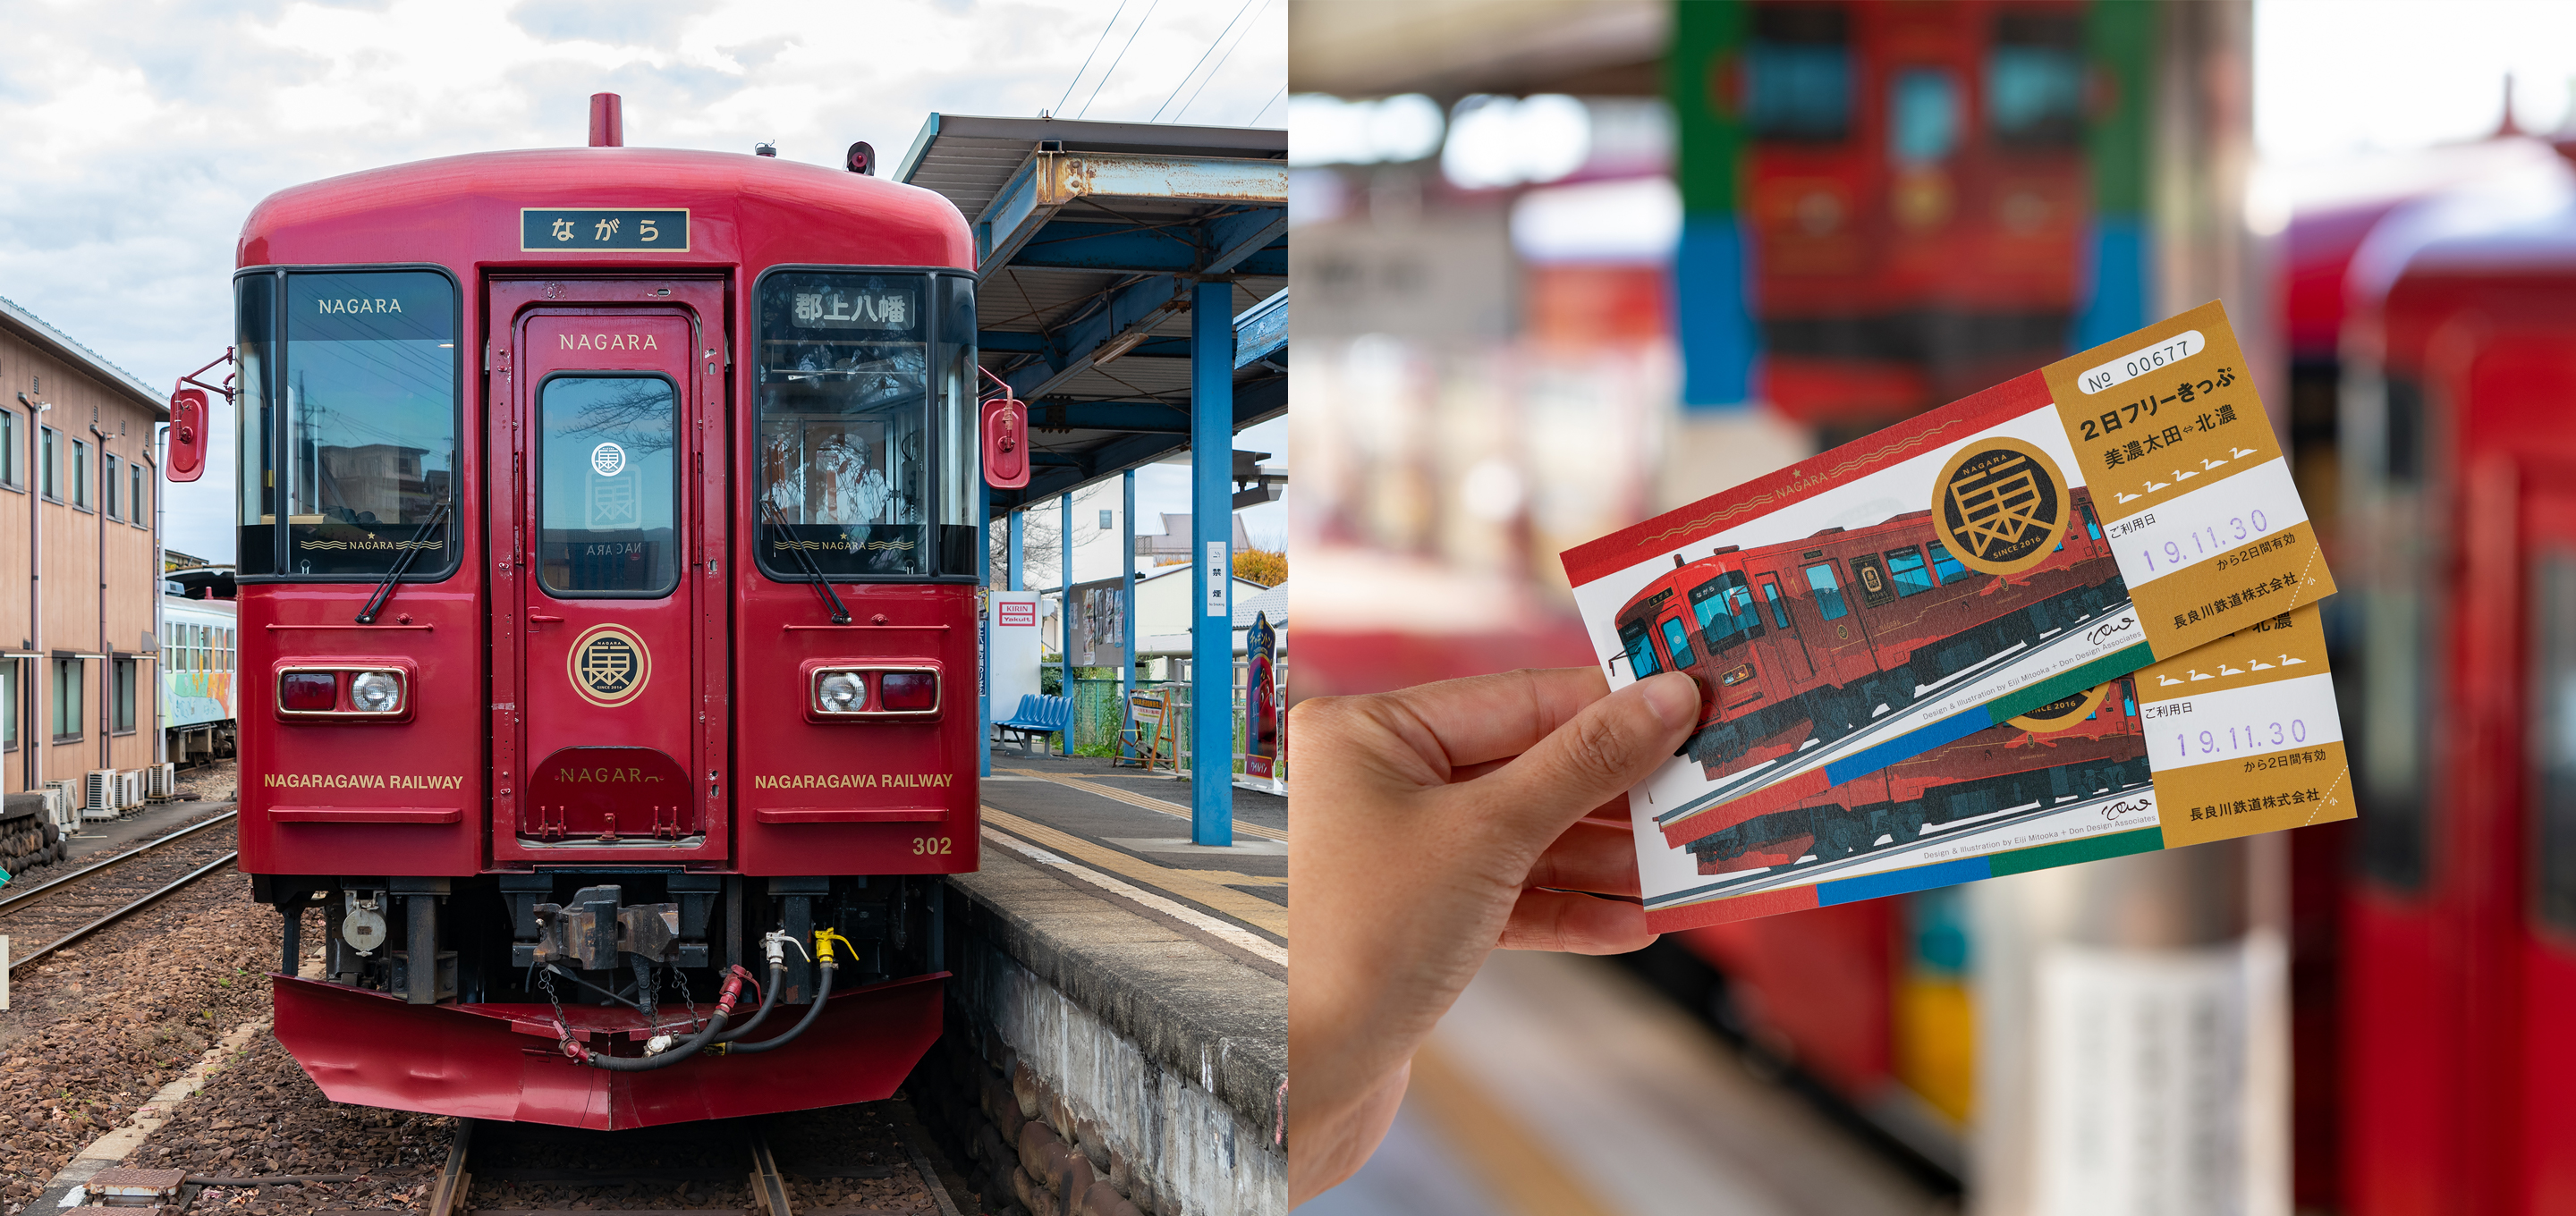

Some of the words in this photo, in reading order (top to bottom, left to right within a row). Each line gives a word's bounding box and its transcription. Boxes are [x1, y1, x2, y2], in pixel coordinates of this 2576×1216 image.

[552, 217, 659, 241] ながら
[318, 299, 402, 315] NAGARA
[794, 292, 905, 323] 郡上八幡
[559, 334, 657, 350] NAGARA
[2126, 341, 2190, 376] 00677
[2080, 367, 2237, 442] 2日フリーきっぷ
[1962, 454, 2007, 475] NAGARA
[1775, 472, 1828, 499] NAGARA
[2109, 513, 2157, 540] ご利用日
[349, 541, 394, 551] NAGARA
[822, 541, 866, 550] NAGARA
[1993, 544, 2018, 559] SINCE
[2021, 536, 2041, 549] 2016
[2216, 533, 2296, 571] から2日間有効
[1212, 568, 1221, 597] 禁煙
[1696, 586, 1715, 598] ながら
[2306, 576, 2317, 587] 小
[2174, 571, 2299, 629] 長良川鉄道株式会社
[1923, 705, 1948, 721] Design
[1949, 702, 1956, 710] &
[1956, 687, 1996, 708] Illustration
[1997, 682, 2007, 692] by
[2008, 676, 2020, 689] Eiji
[2021, 666, 2050, 684] Mitooka
[2059, 657, 2074, 668] Don
[2075, 646, 2101, 662] Design
[2102, 630, 2142, 650] Associates
[2055, 700, 2076, 710] 2016
[2145, 702, 2193, 720] ご利用日
[2177, 719, 2306, 756] 19.11.30
[2243, 748, 2326, 773] から2日間有効
[264, 773, 385, 789] NAGARAGAWA
[390, 774, 463, 790] RAILWAY
[755, 774, 877, 789] NAGARAGAWA
[881, 773, 953, 788] RAILWAY
[2190, 788, 2321, 822] 長良川鉄道株式会社
[2328, 796, 2338, 806] 小
[912, 838, 952, 855] 302
[1924, 850, 1950, 860] Design
[1952, 847, 1958, 855] &
[1960, 840, 2002, 853] Illustration
[2003, 838, 2012, 847] by
[2014, 834, 2027, 845] Eiji
[2029, 830, 2059, 841] Mitooka
[2069, 825, 2085, 835] Don
[2086, 821, 2113, 833] Design
[2114, 815, 2157, 828] Associates
